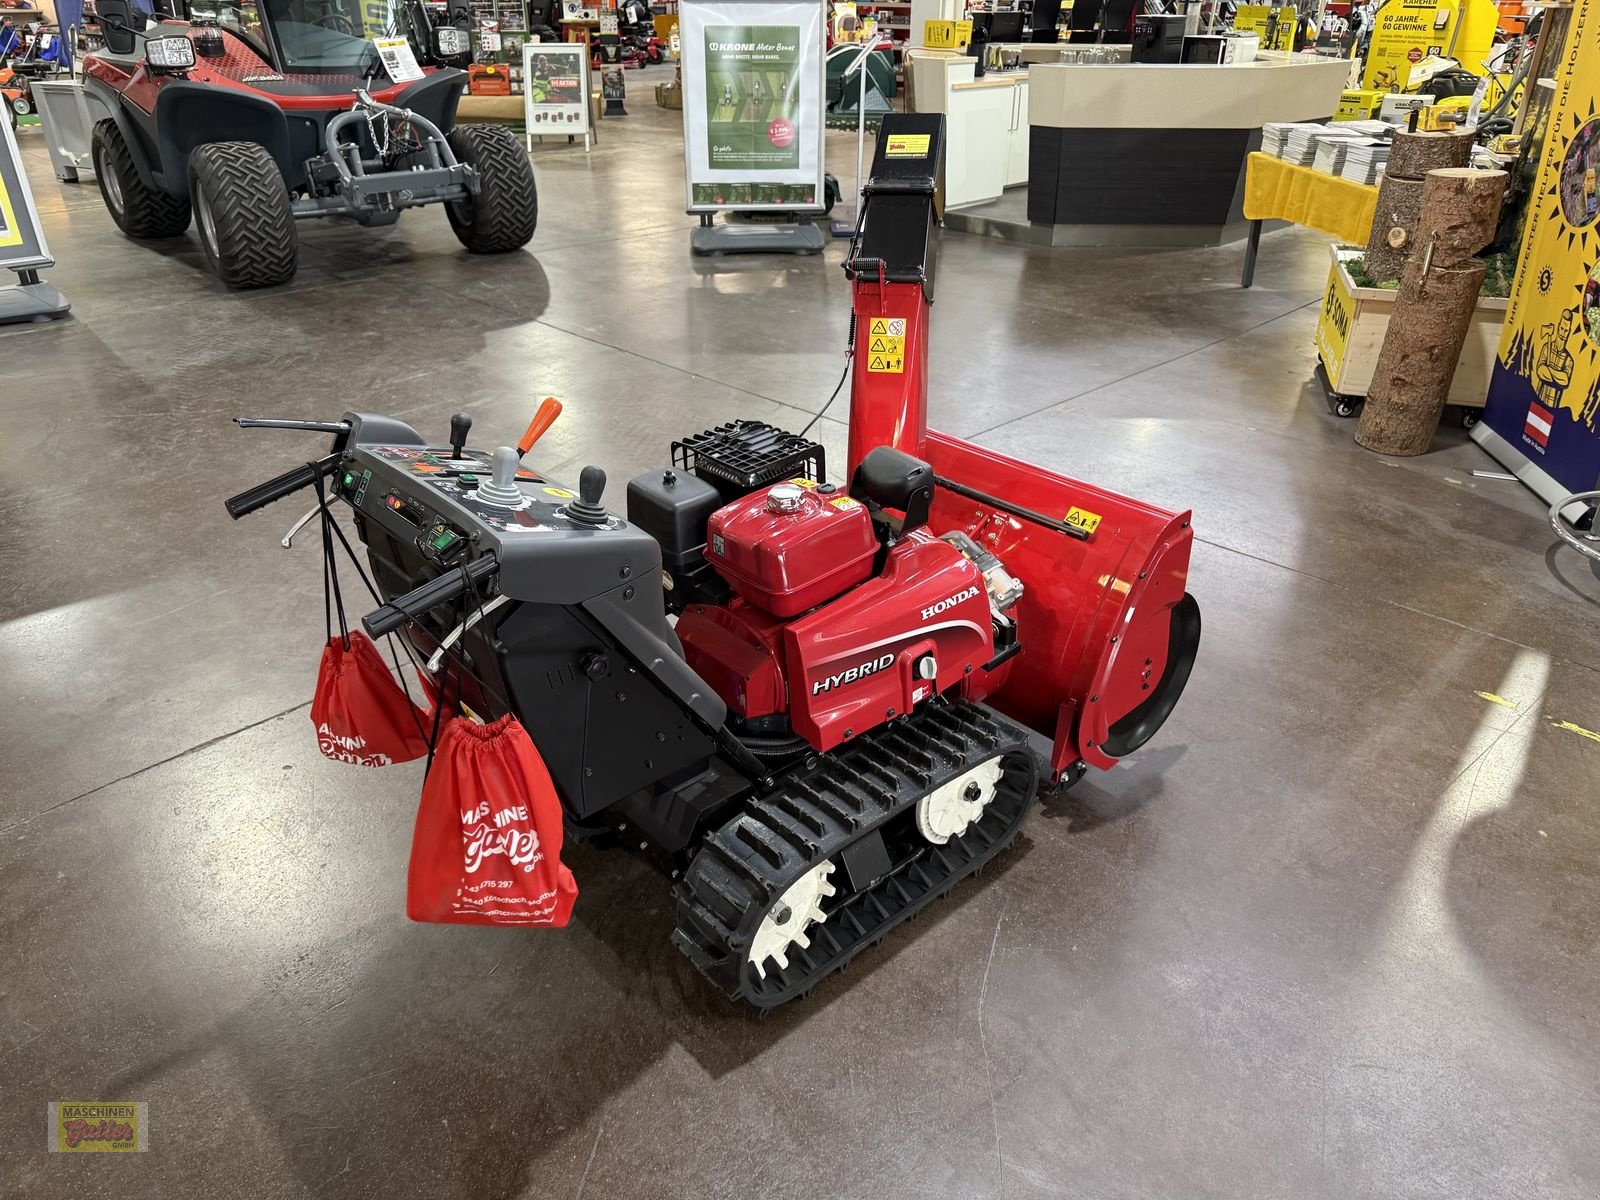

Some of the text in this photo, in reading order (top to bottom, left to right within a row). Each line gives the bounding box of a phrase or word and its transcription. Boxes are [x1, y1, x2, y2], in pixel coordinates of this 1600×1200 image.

[1509, 301, 1518, 325] IHR
[1516, 212, 1539, 298] PERFEKTER
[1536, 147, 1555, 209] HELFER
[1552, 112, 1563, 142] FÜR
[1560, 80, 1571, 107] DIE
[921, 586, 980, 620] HONDA
[812, 653, 895, 695] HYBRID
